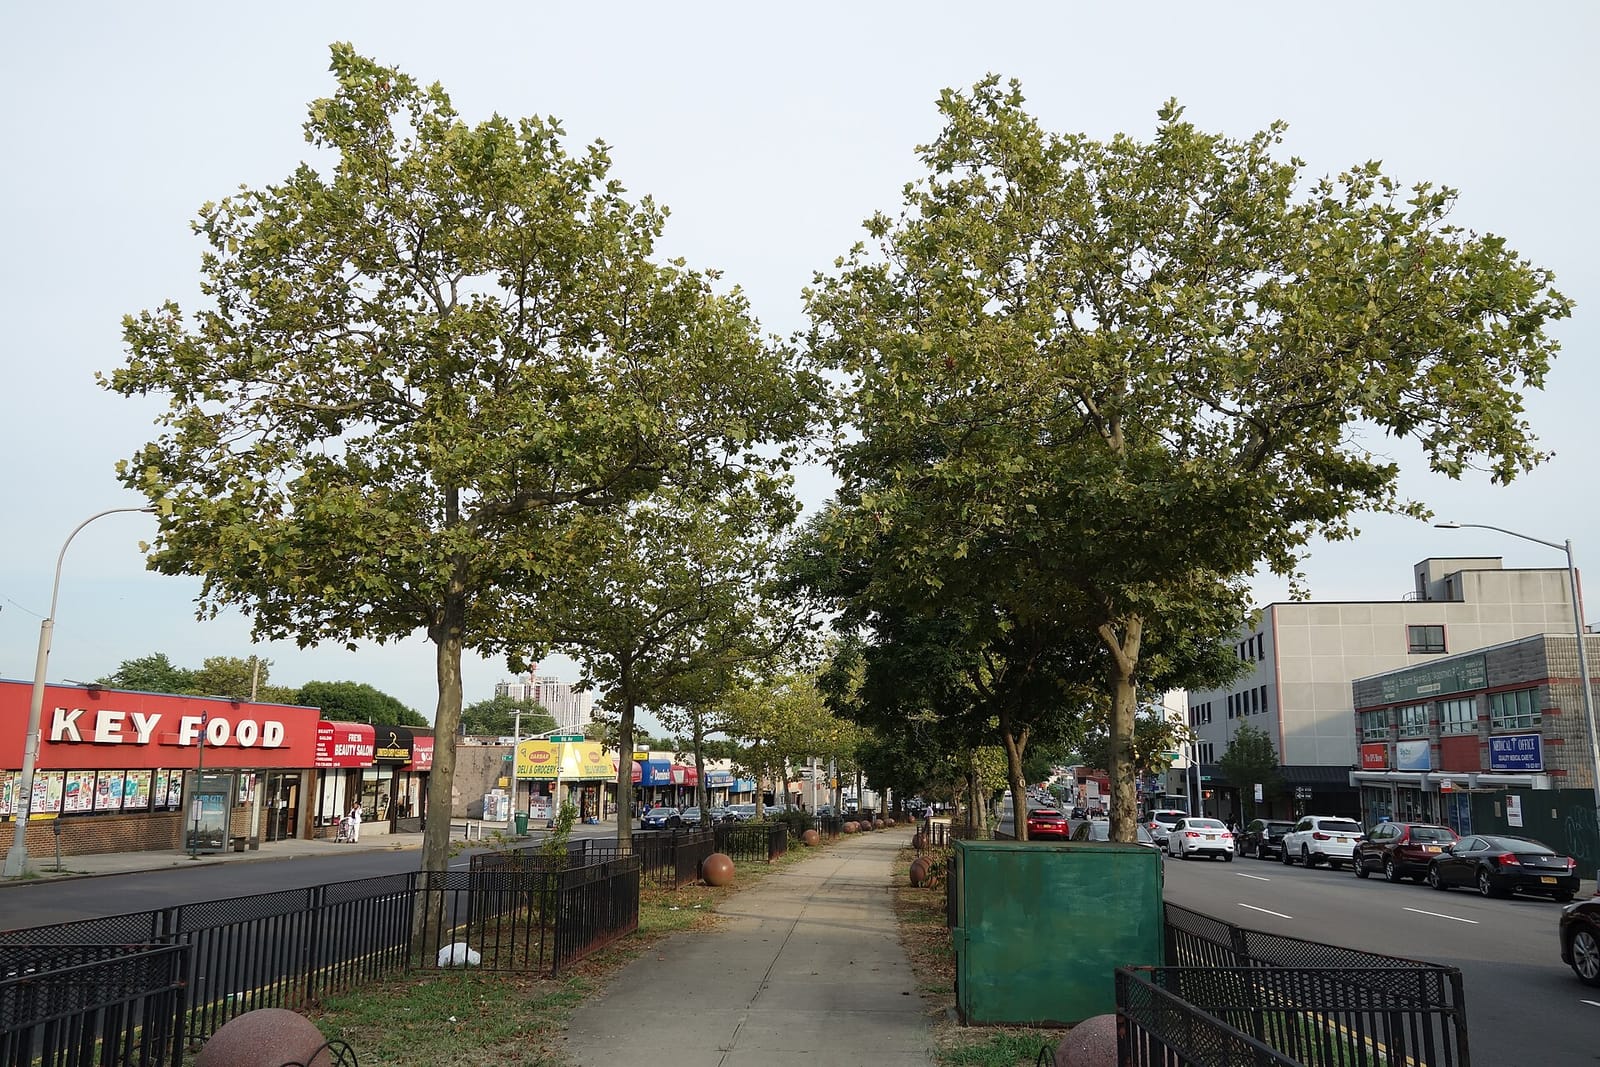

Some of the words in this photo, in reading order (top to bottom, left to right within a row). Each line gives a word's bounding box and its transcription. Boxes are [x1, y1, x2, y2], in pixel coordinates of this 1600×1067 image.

[50, 707, 163, 744] KEY
[178, 715, 285, 748] FOOD
[335, 743, 356, 756] BEAUTY
[356, 744, 374, 757] SALON
[1493, 740, 1512, 751] MEDICAL
[1518, 738, 1535, 750] OFFICE
[517, 764, 528, 774] DELI
[534, 764, 557, 774] GROCERY
